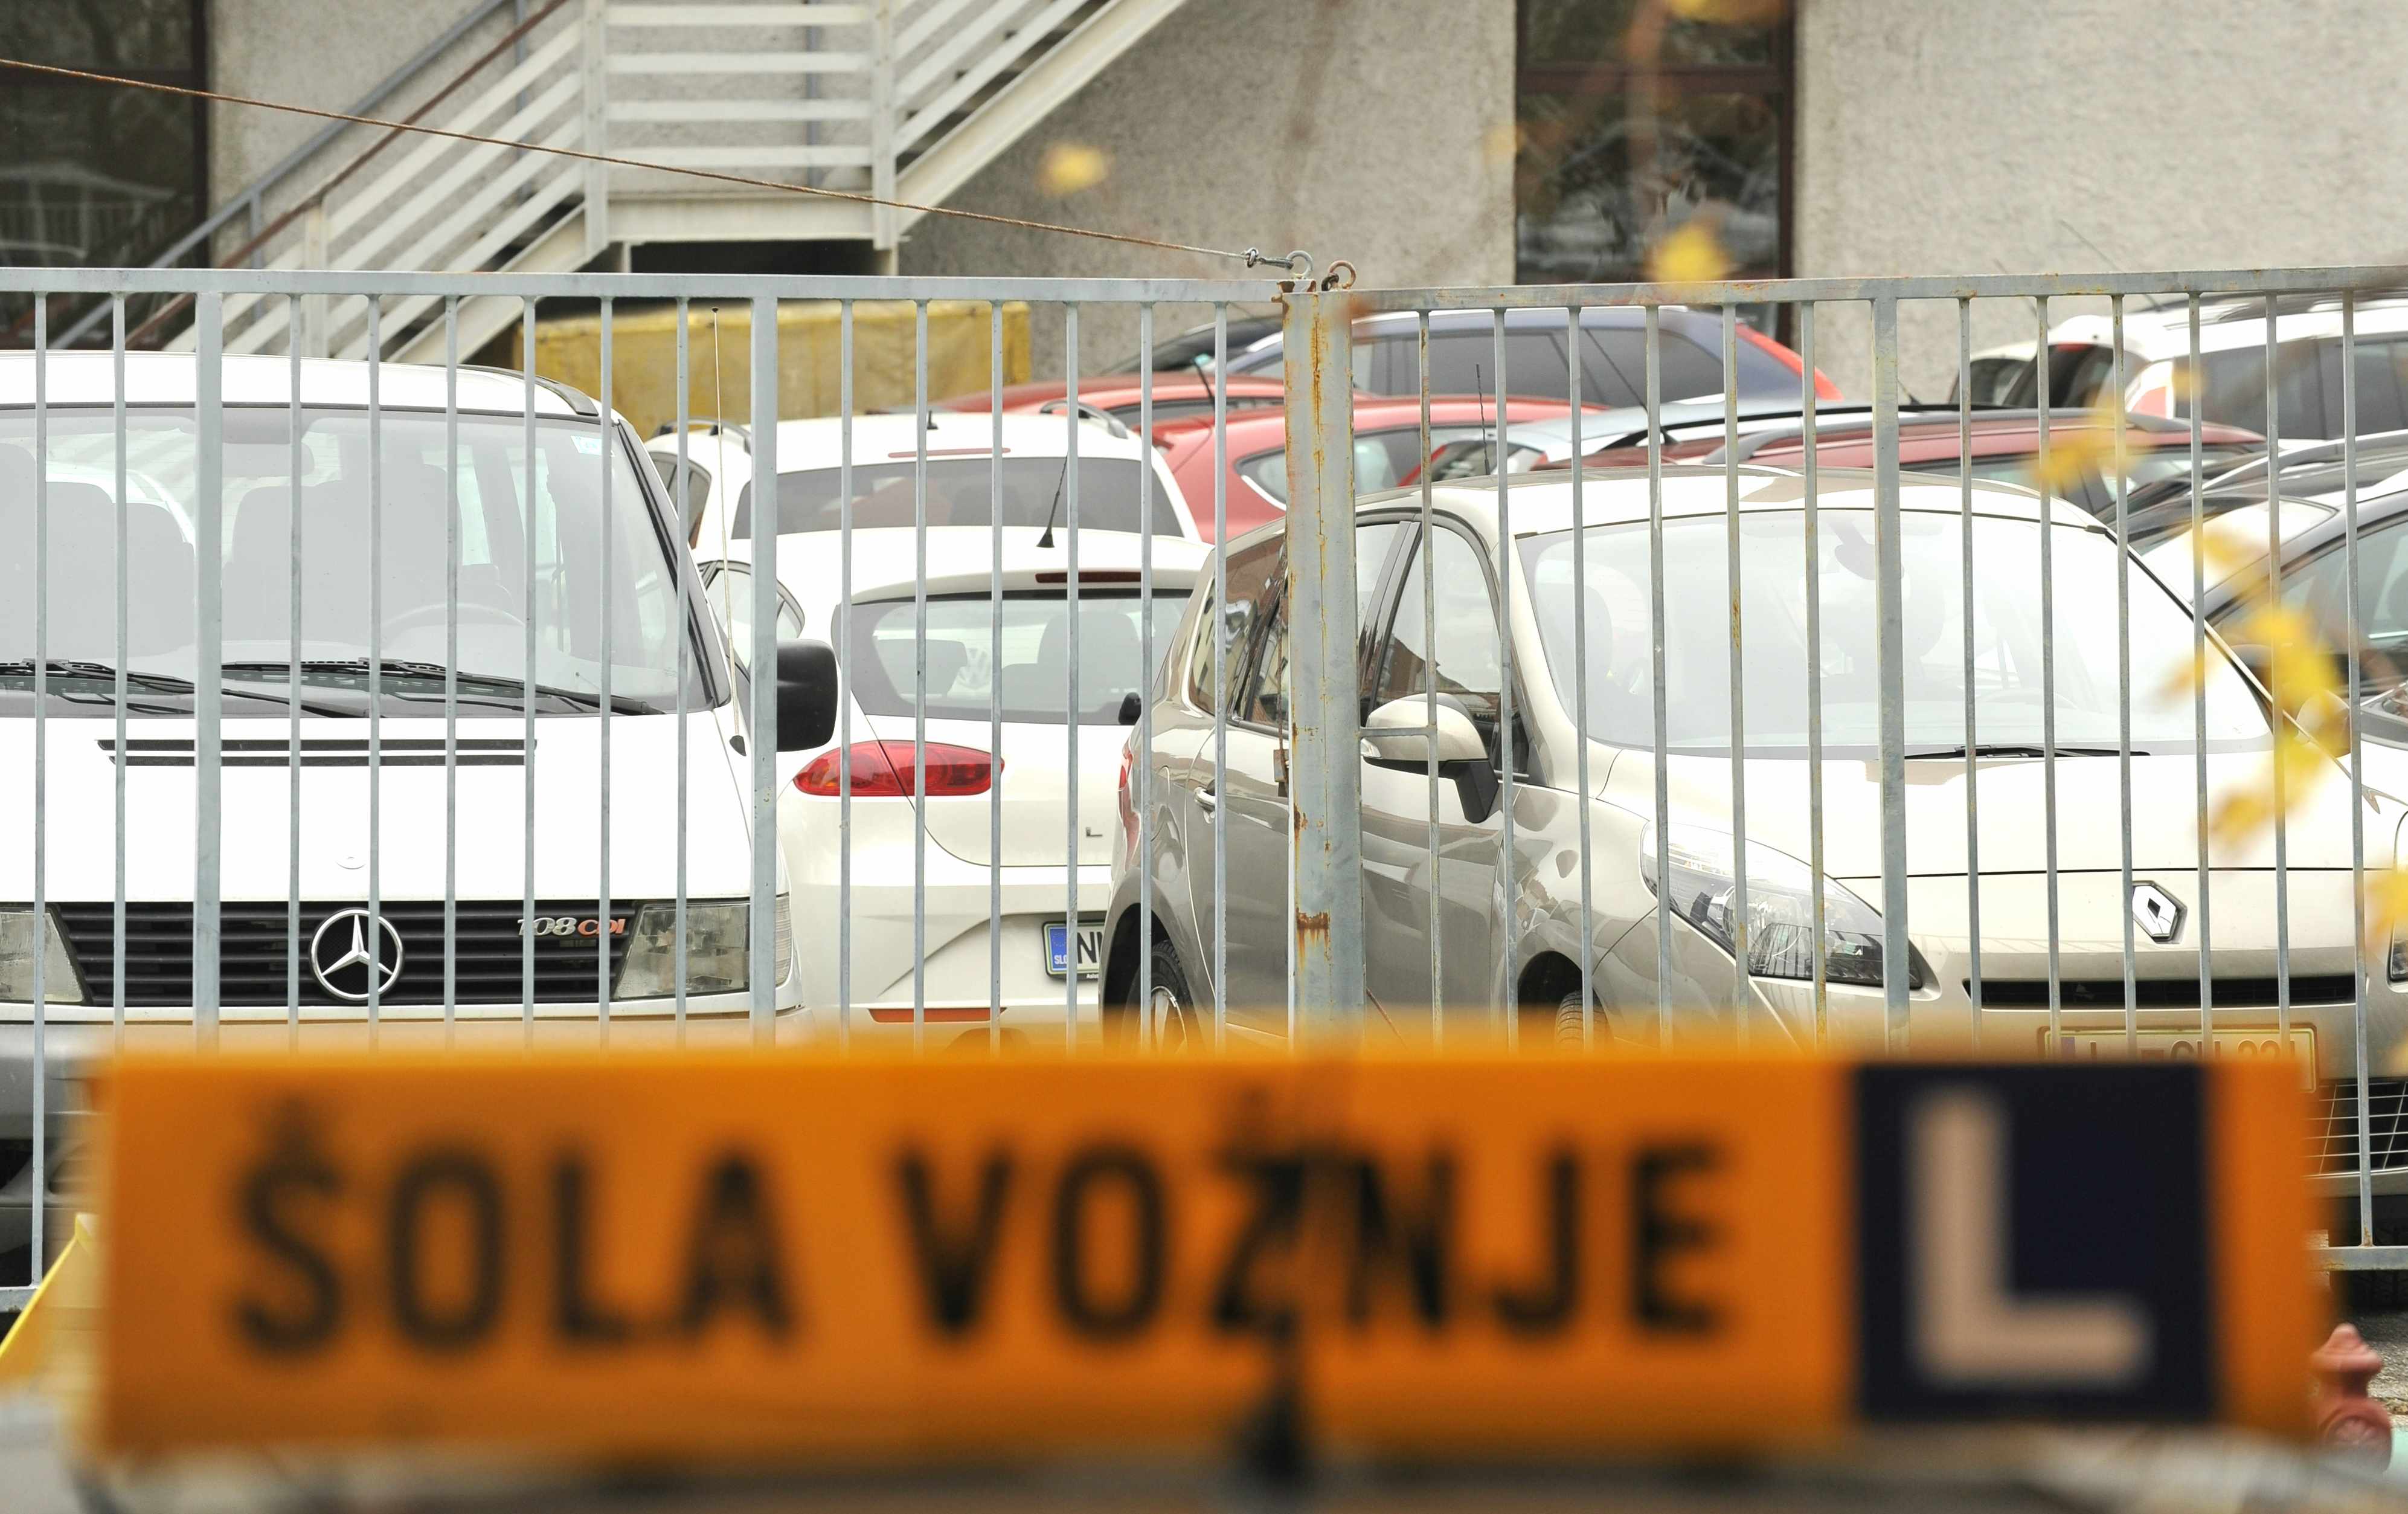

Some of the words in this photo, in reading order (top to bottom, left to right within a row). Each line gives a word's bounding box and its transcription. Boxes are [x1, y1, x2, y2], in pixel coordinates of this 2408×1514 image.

[233, 1095, 797, 1359] ŠOLA
[891, 1084, 1724, 1342] VOŽNJE
[1909, 1095, 2155, 1379] L
